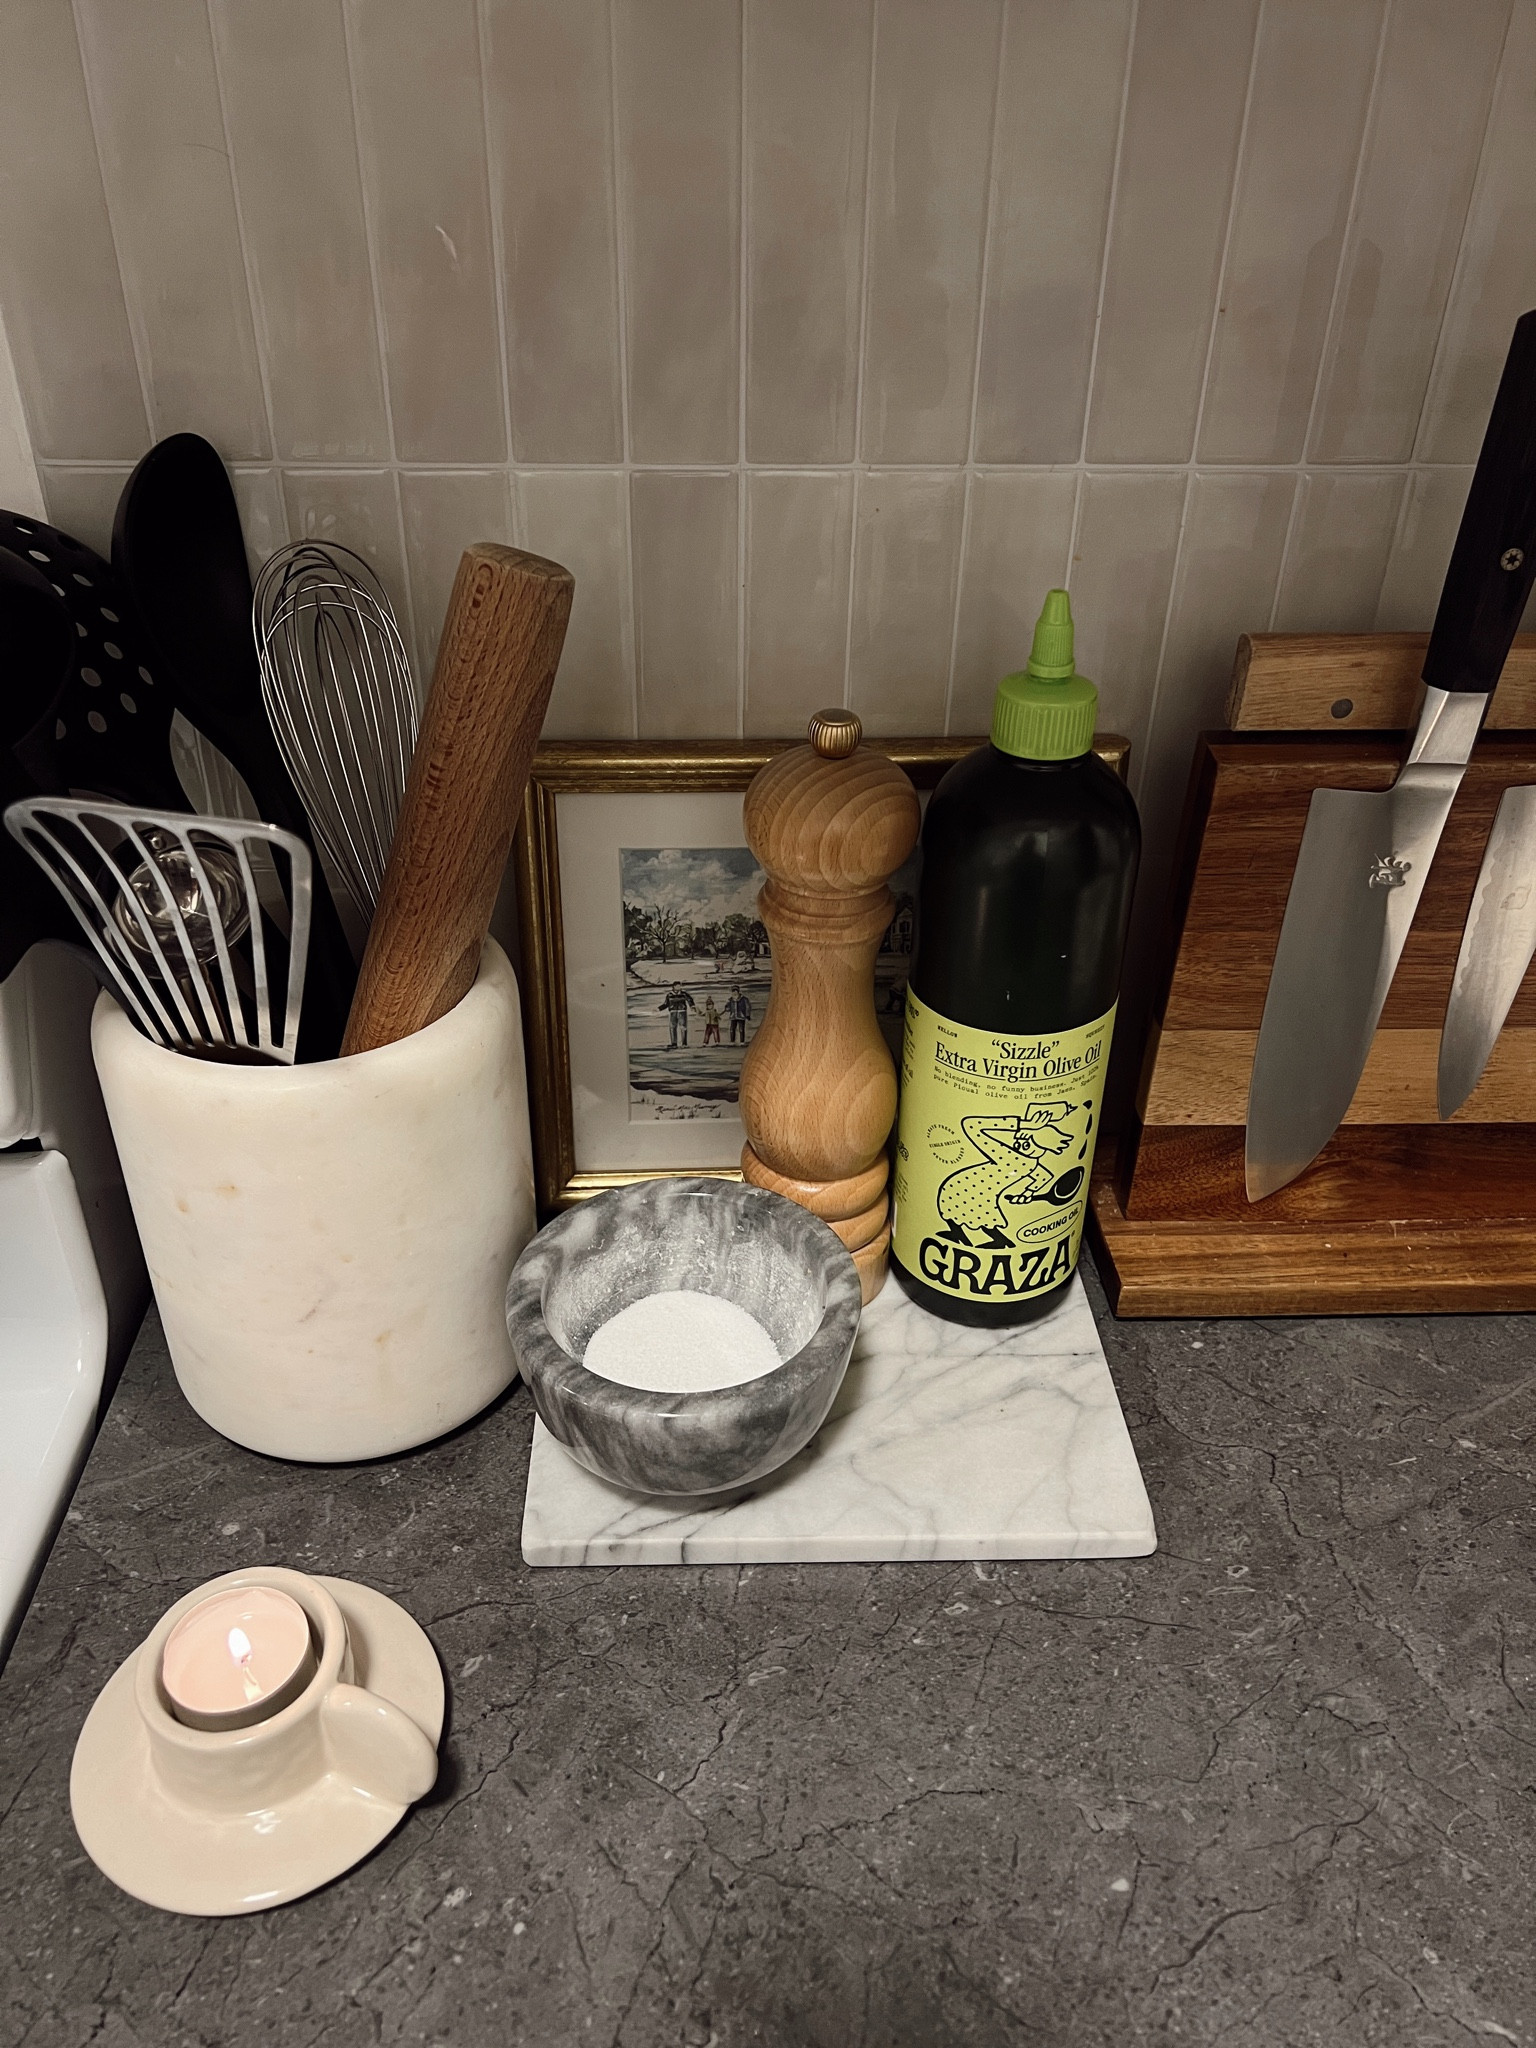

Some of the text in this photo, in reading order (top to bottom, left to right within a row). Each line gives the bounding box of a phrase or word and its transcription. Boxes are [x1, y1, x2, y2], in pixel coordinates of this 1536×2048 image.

[935, 1040, 977, 1073] Extra
[982, 1057, 1037, 1084] Virgin
[1043, 1057, 1082, 1077] Olive
[1084, 1040, 1102, 1065] Oil
[985, 1091, 1009, 1099] olive
[1034, 1091, 1053, 1099] from
[1001, 1085, 1026, 1094] funny
[1023, 1216, 1067, 1238] COOKING
[919, 1235, 1070, 1295] GRAZA
